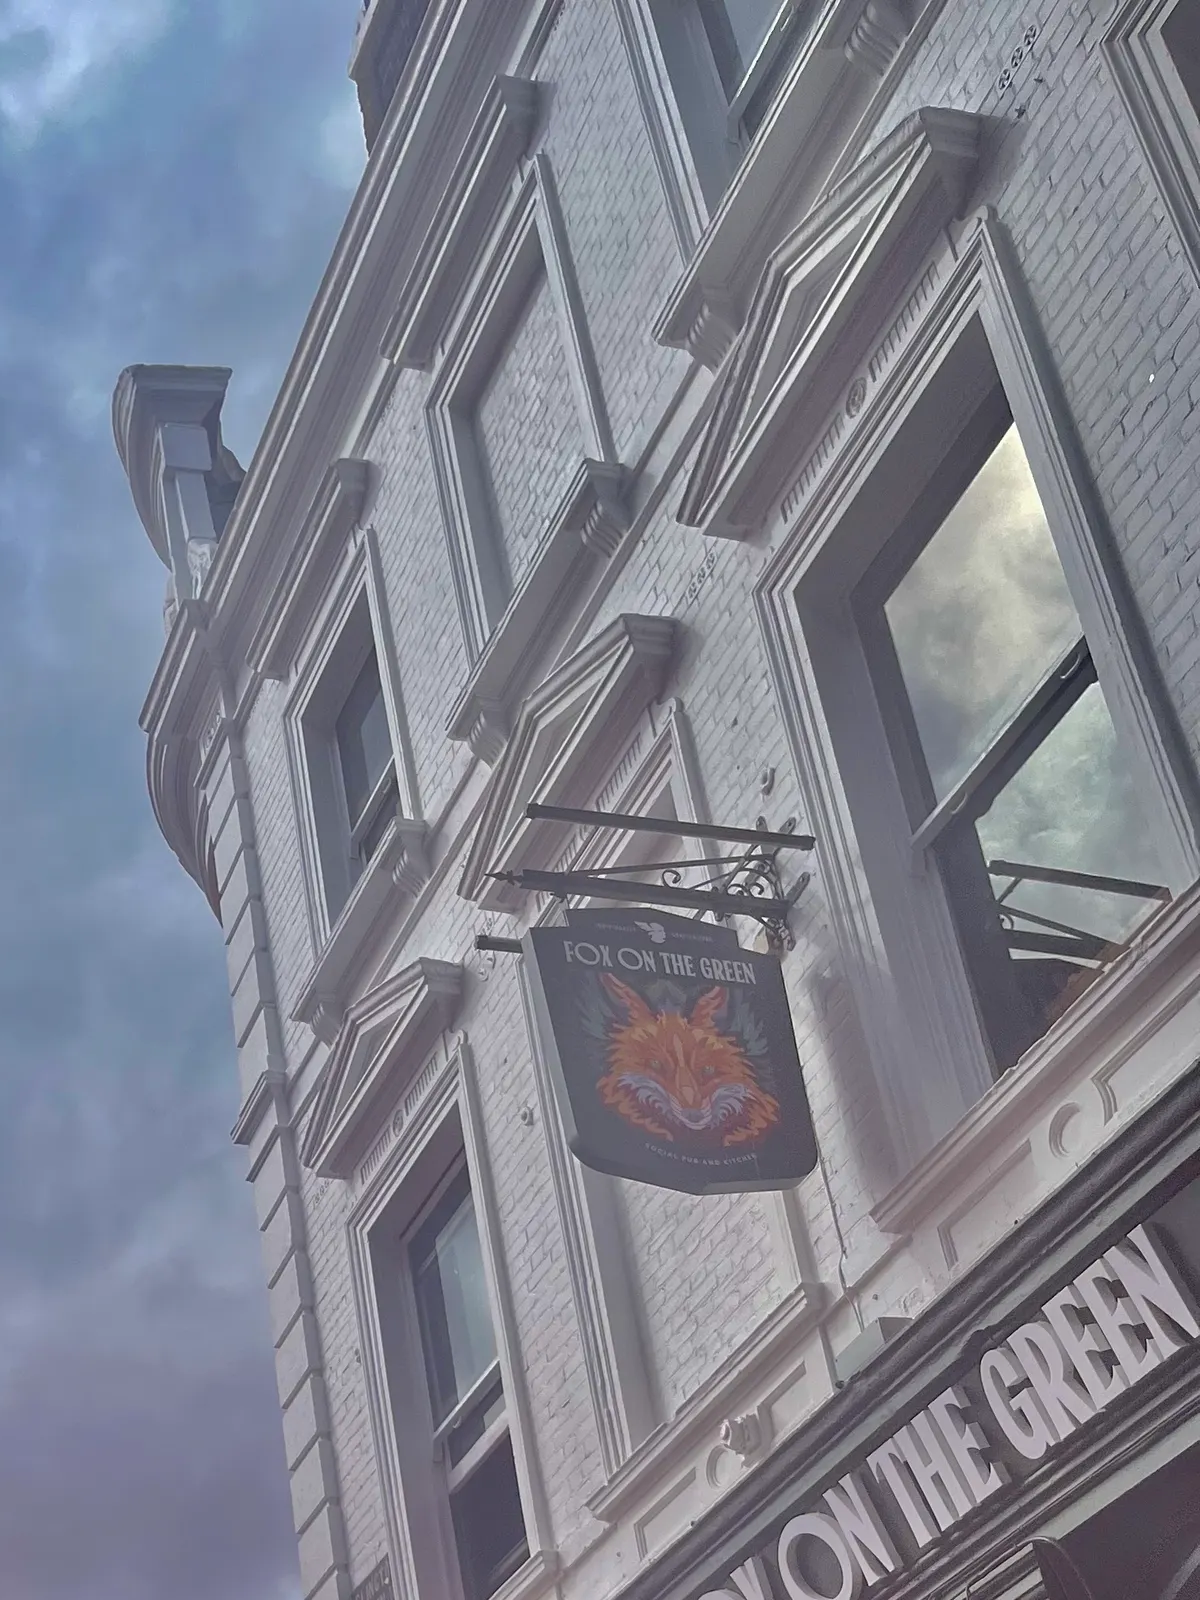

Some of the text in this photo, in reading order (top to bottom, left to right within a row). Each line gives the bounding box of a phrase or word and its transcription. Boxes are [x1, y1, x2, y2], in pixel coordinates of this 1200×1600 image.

[563, 940, 757, 985] FOX ON THE GREEN
[645, 1142, 679, 1160] SOCIAL
[681, 1155, 700, 1165] PUB
[702, 1158, 721, 1167] AND
[866, 1385, 1007, 1549] THE
[980, 1222, 1200, 1460] GREEN
